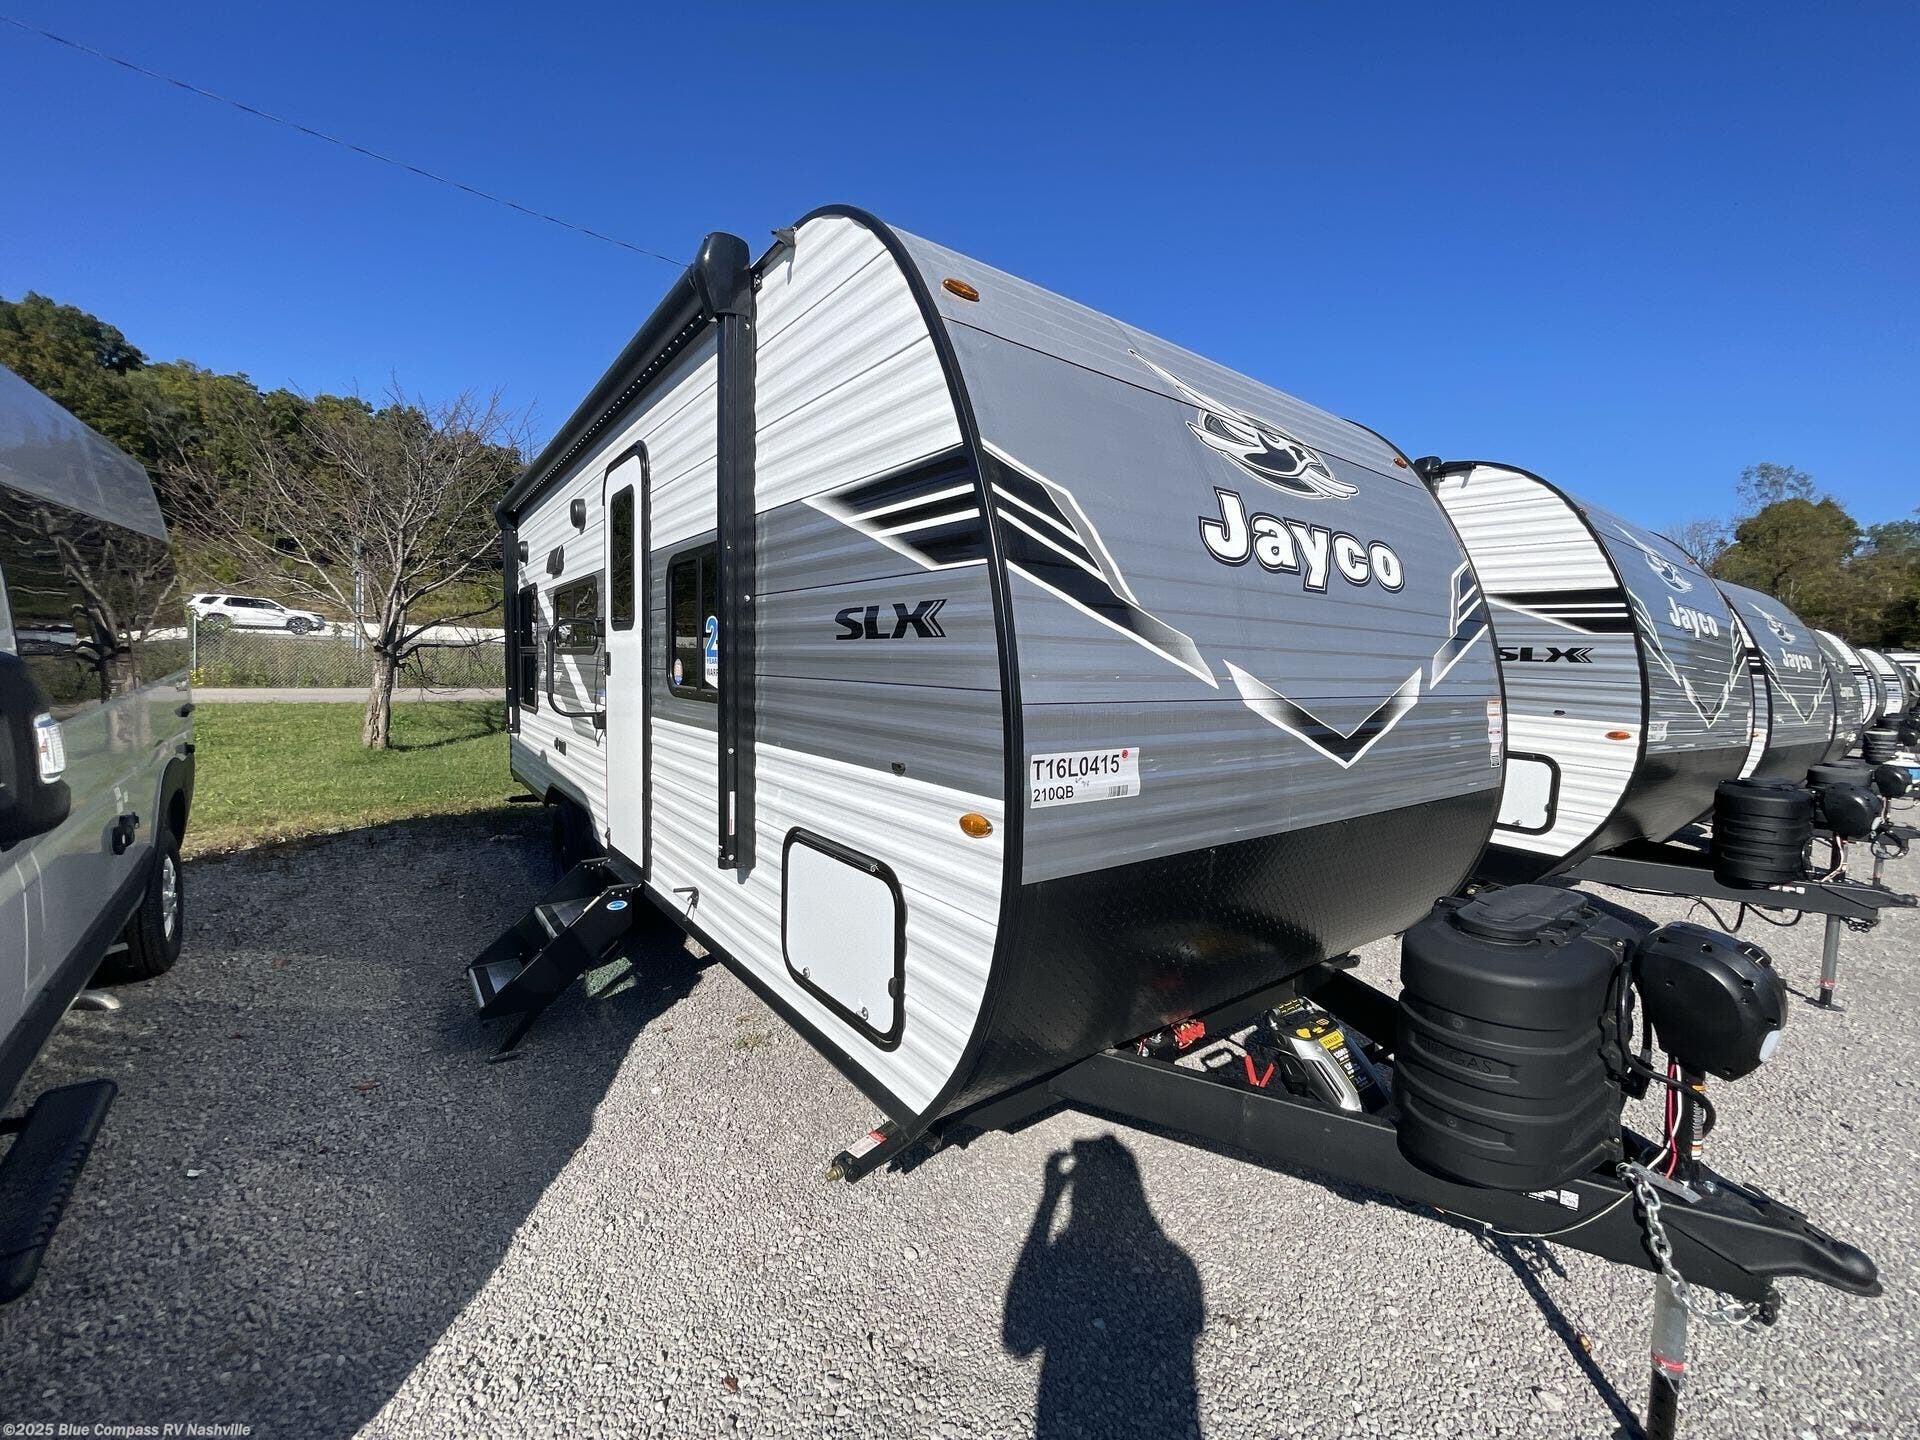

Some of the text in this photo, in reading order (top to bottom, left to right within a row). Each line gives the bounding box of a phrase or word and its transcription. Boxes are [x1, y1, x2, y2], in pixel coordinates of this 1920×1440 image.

[1198, 486, 1405, 594] Jayco
[835, 599, 947, 640] SLX
[1667, 596, 1719, 639] Jayco
[706, 616, 718, 657] 2
[1498, 647, 1594, 663] SLX
[1782, 647, 1814, 673] Jayco
[1033, 754, 1120, 780] T16L0415
[1033, 785, 1074, 802] 210QB
[1447, 1049, 1492, 1073] GAS
